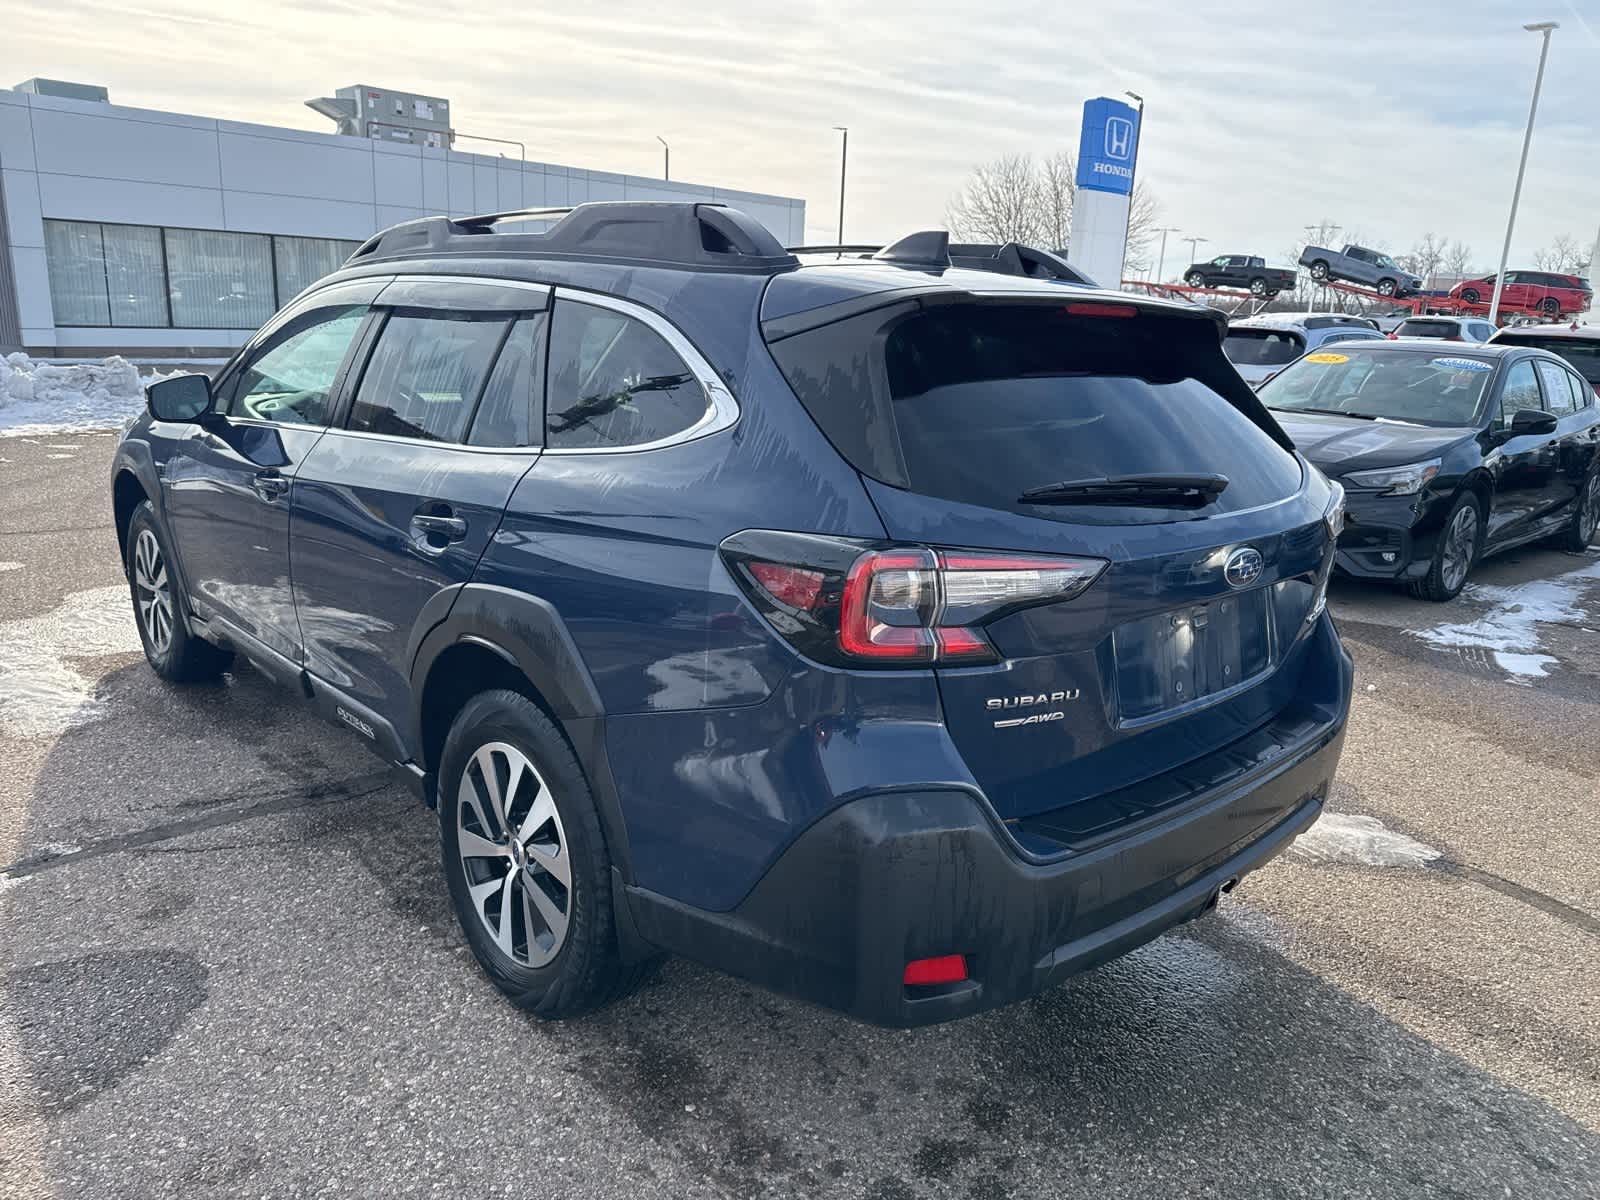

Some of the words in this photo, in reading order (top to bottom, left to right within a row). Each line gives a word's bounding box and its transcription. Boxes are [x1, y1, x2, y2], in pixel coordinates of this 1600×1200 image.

[1093, 162, 1133, 178] HONDA
[986, 688, 1080, 710] SUBARU
[1021, 711, 1065, 725] AWD
